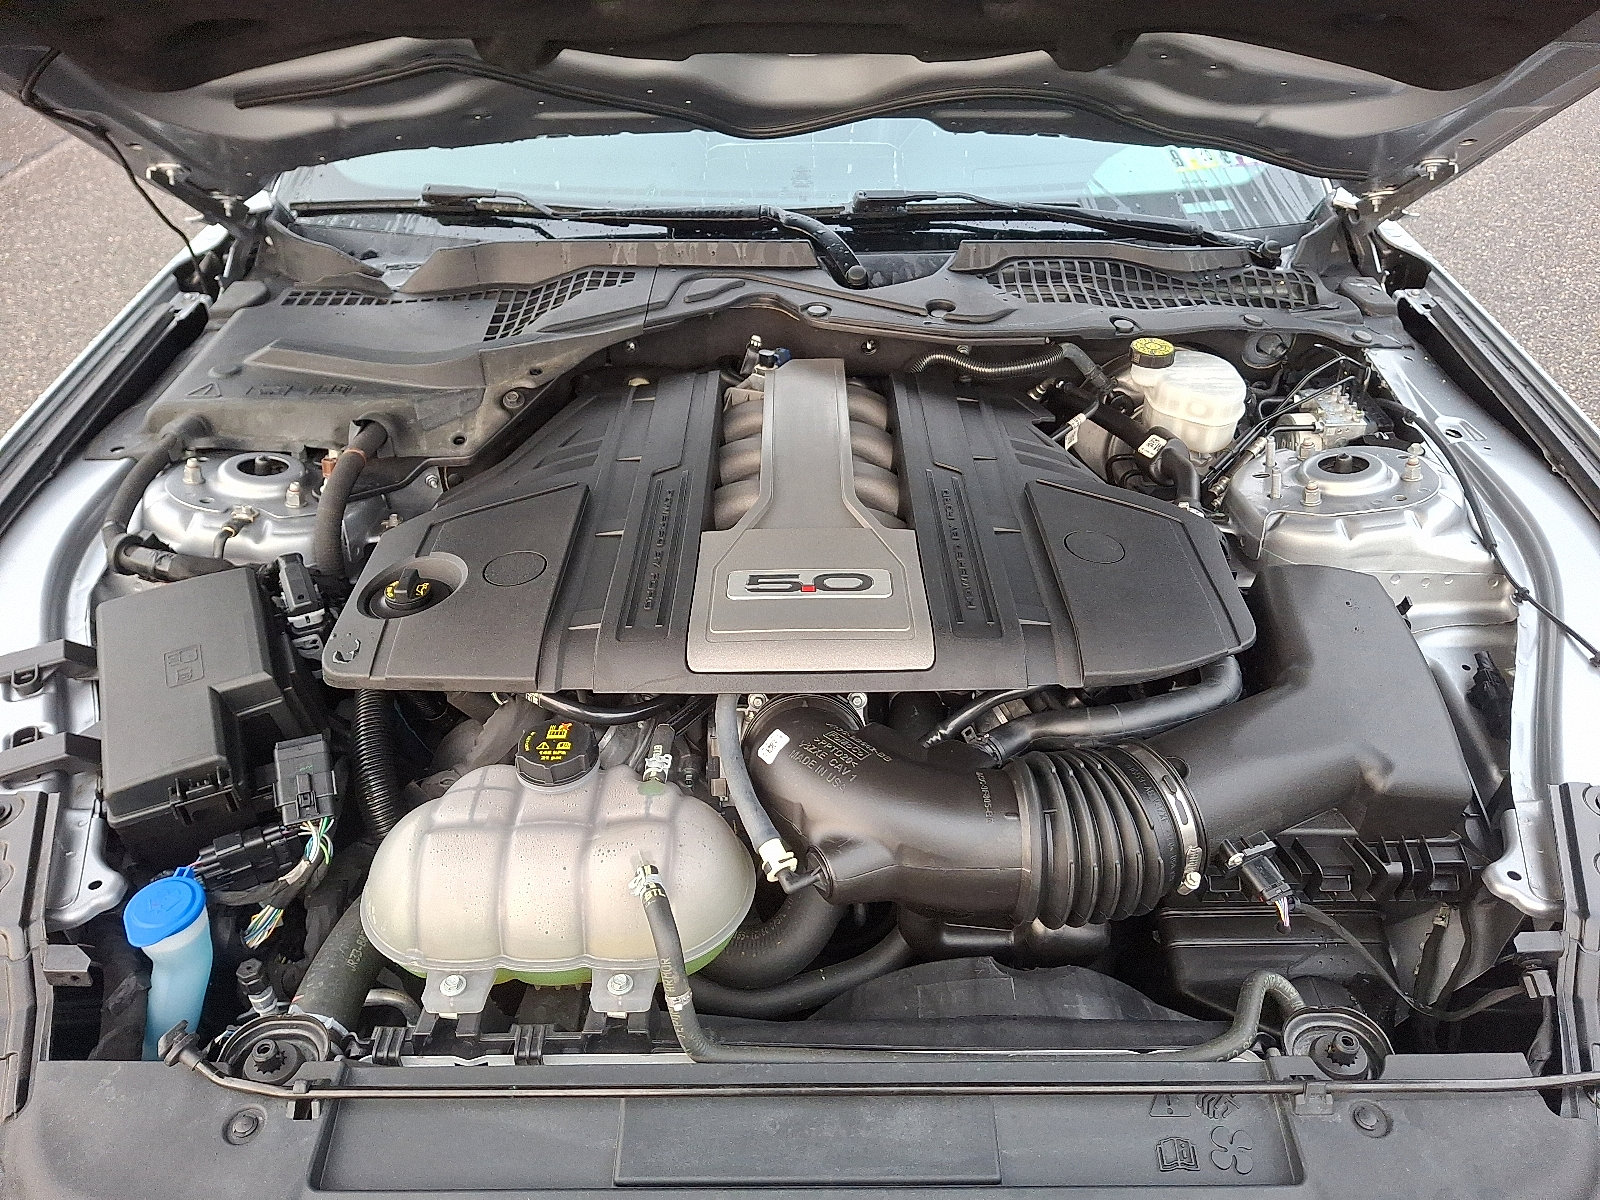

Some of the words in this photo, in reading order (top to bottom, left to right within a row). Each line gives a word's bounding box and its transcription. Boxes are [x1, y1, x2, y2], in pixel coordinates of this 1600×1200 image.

[746, 573, 874, 592] 5.0
[788, 750, 817, 769] MADE
[815, 765, 827, 776] IN
[826, 773, 847, 793] USA
[828, 758, 851, 775] CAV
[660, 957, 675, 993] ARMOR
